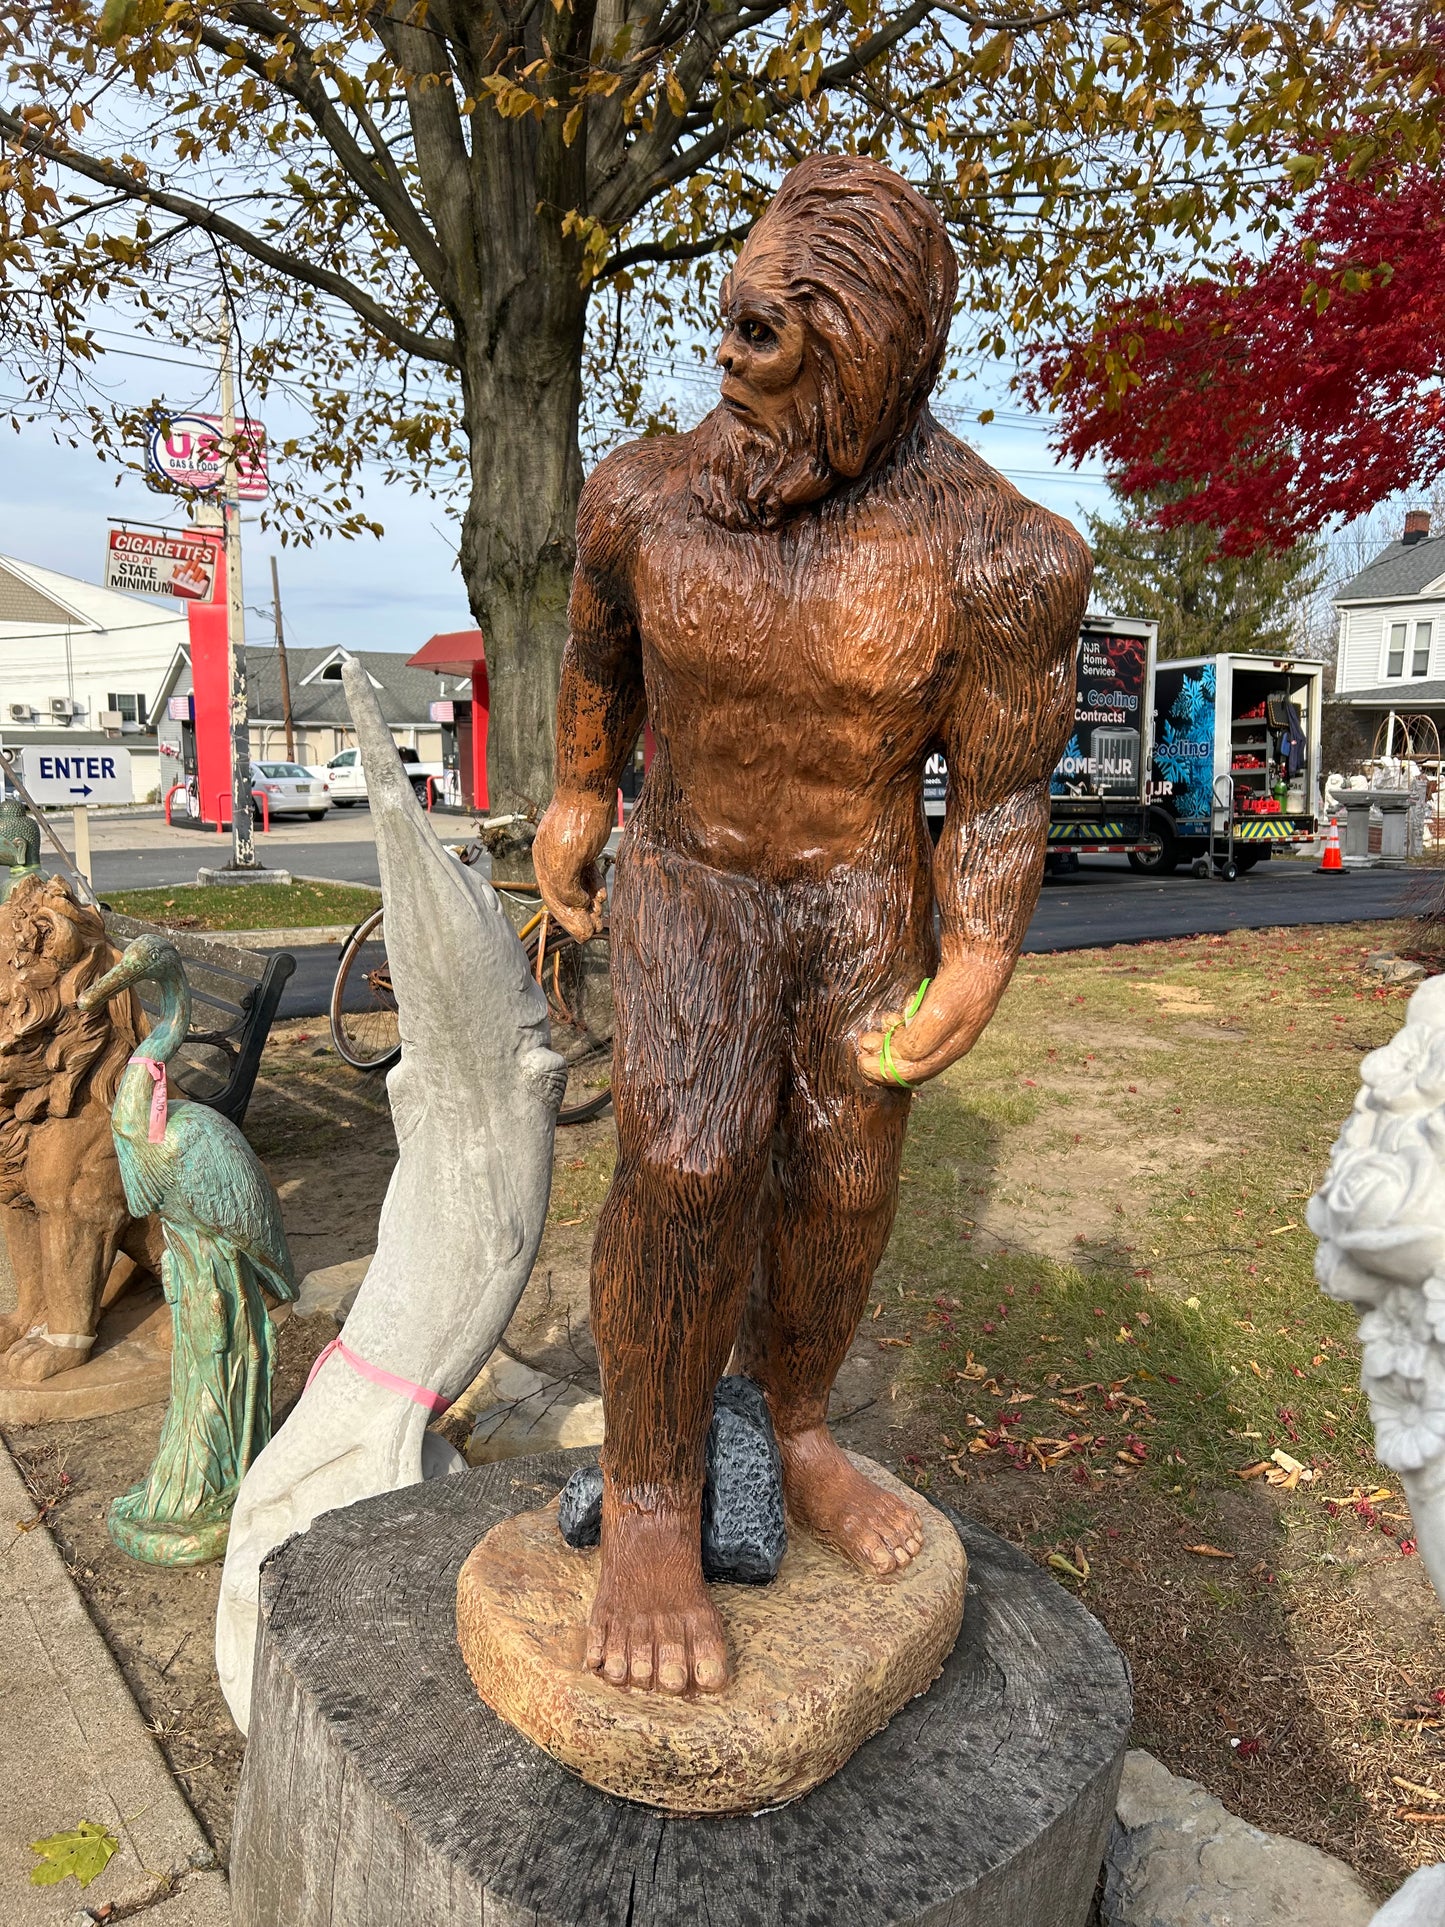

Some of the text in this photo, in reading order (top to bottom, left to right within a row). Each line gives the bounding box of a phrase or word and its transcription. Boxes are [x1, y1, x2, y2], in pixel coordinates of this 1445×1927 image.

[169, 459, 186, 469] GAS
[188, 461, 194, 470] &
[115, 535, 213, 563] CIGARETTES
[113, 551, 154, 566] SOLD AT
[118, 562, 158, 580] STATE
[111, 575, 173, 594] MINIMUM
[1083, 642, 1101, 654] NJR
[1083, 653, 1108, 666] Home
[1082, 664, 1116, 677] Services
[1076, 689, 1138, 711] & Cooling
[1074, 708, 1126, 724] Contracts!
[40, 757, 116, 779] ENTER
